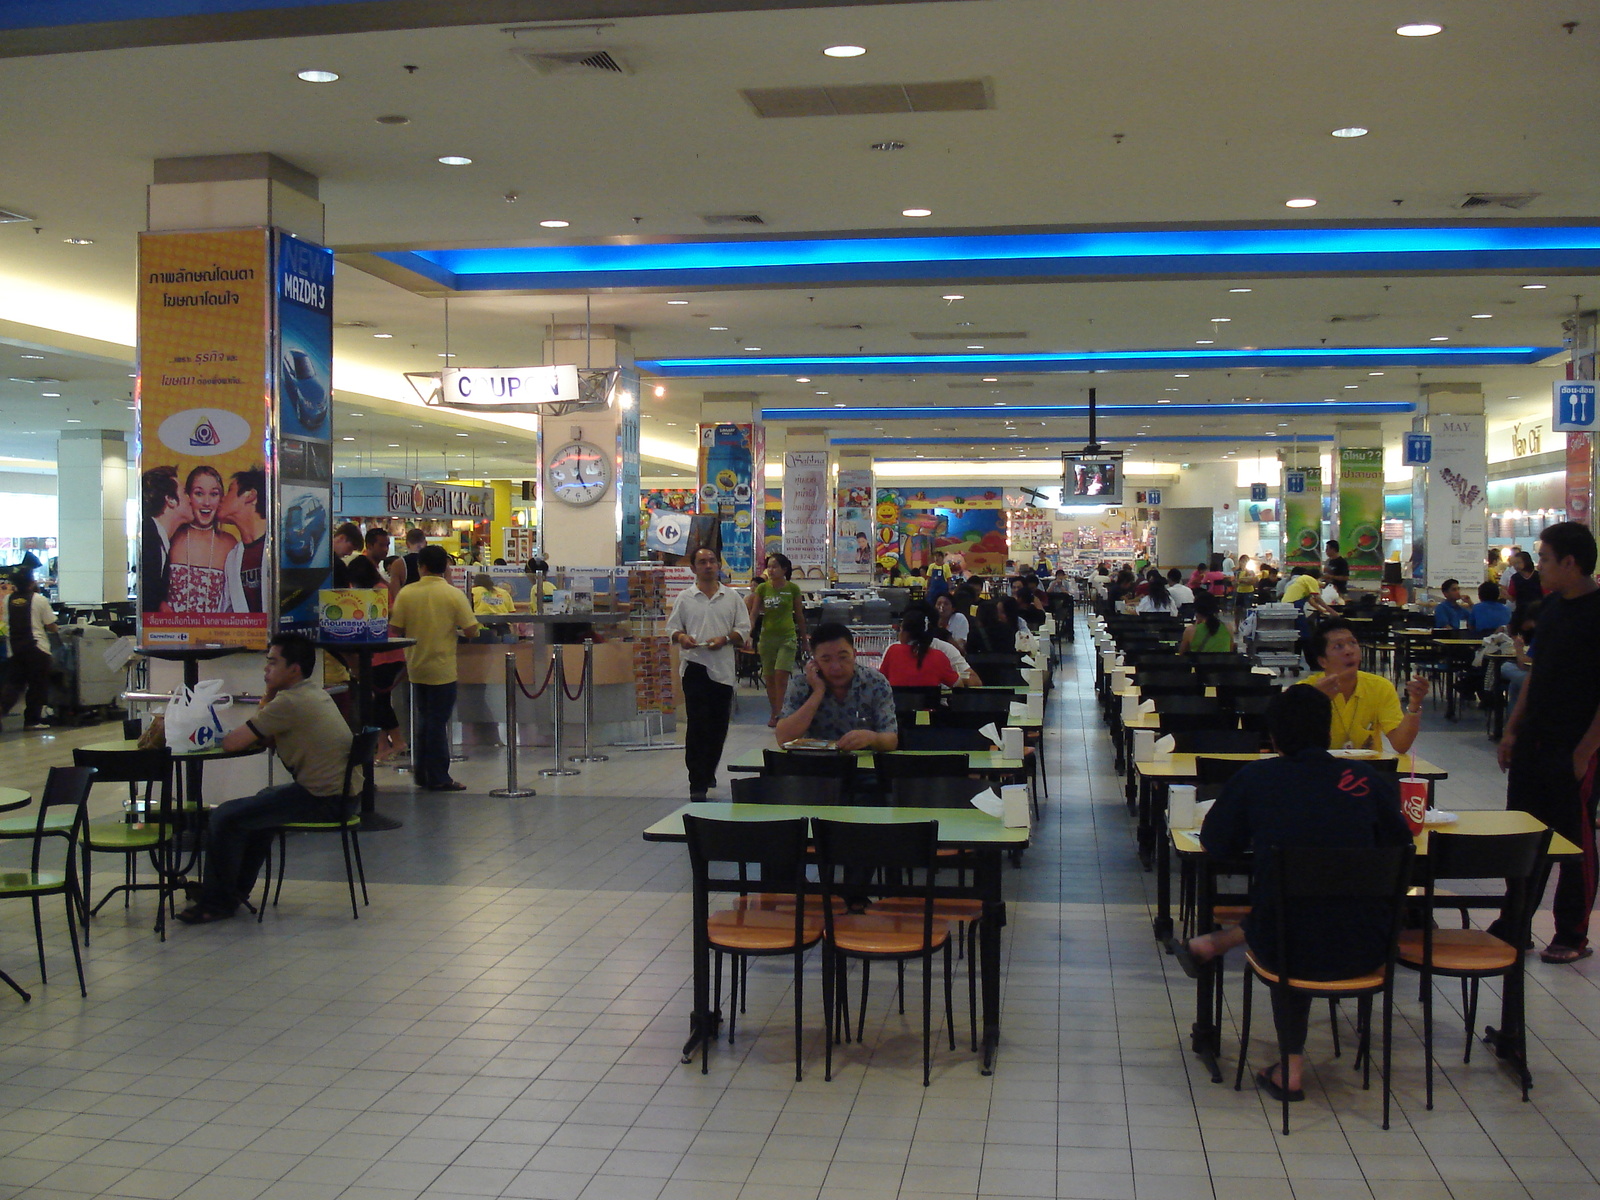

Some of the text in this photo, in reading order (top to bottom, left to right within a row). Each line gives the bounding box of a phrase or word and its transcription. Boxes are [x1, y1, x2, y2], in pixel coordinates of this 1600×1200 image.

[163, 290, 239, 307] โฆษณาโดนใจ
[284, 272, 326, 309] MAZDA 3
[458, 375, 560, 398] CUPN
[1443, 422, 1471, 431] MAY
